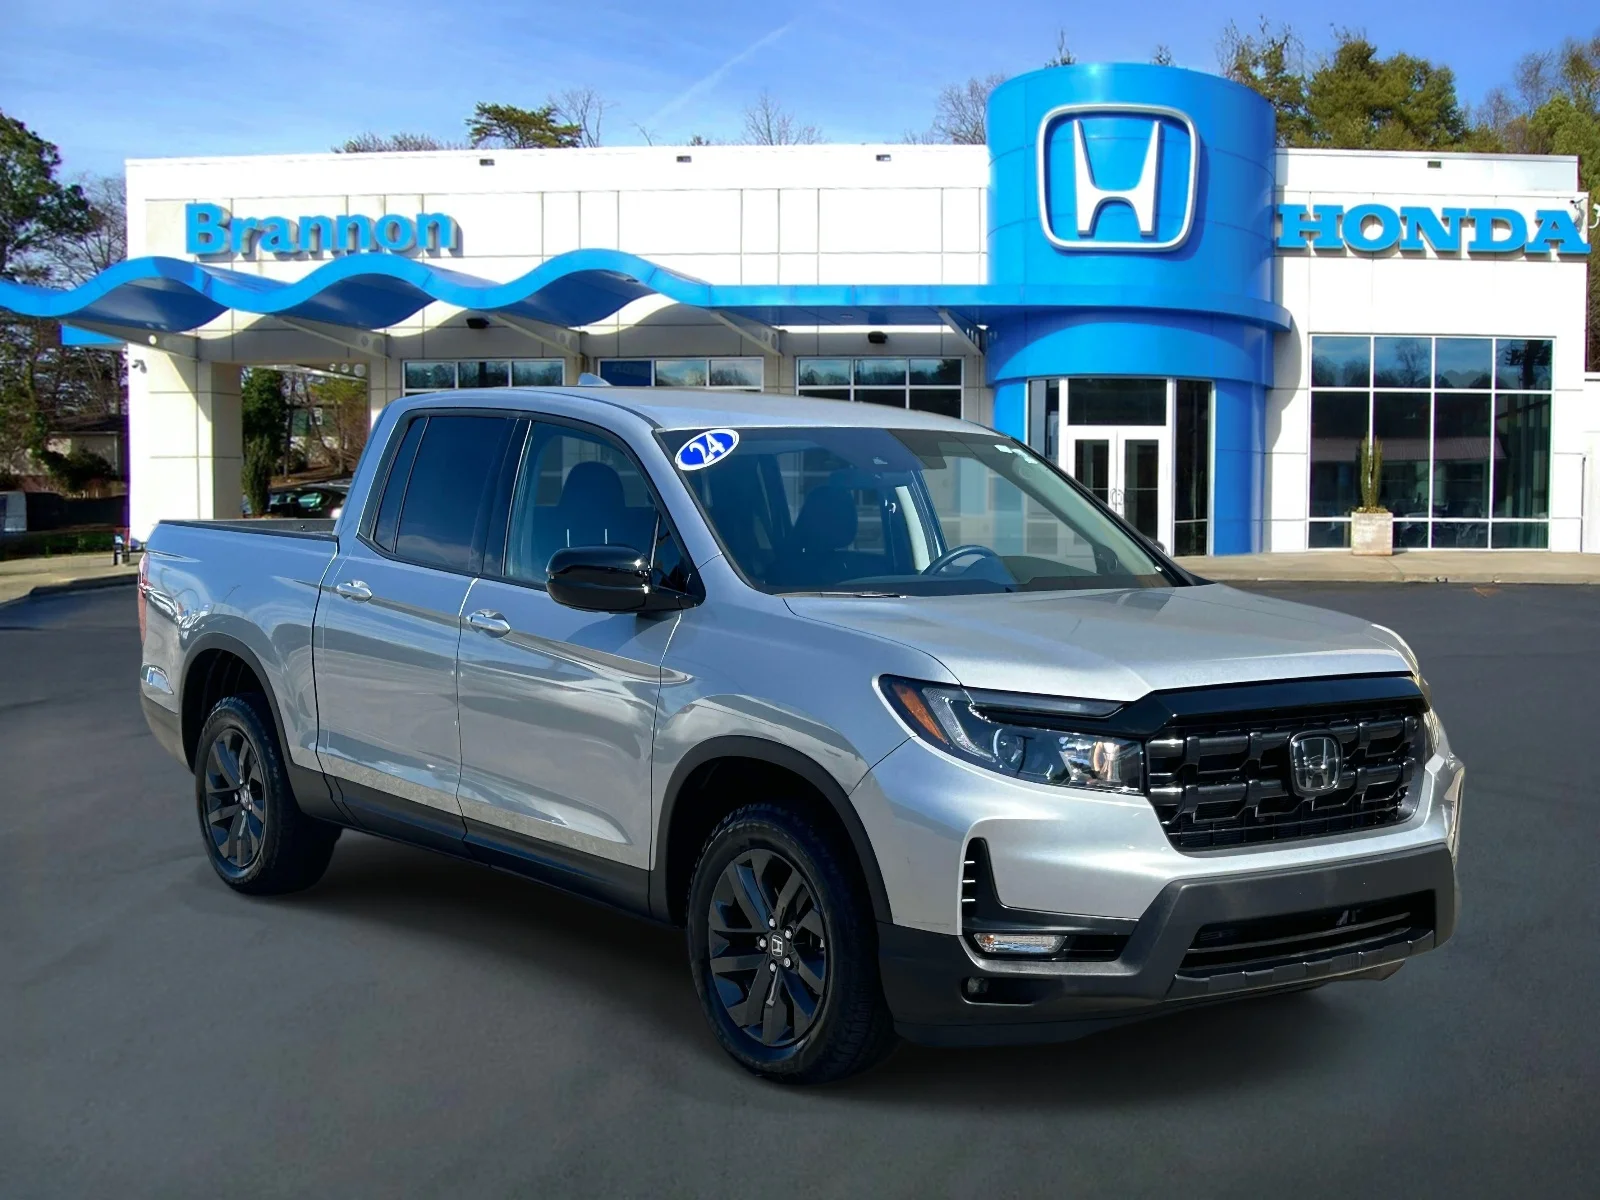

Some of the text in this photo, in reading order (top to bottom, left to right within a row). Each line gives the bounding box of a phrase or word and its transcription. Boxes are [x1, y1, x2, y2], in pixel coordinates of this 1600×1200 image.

[185, 202, 458, 255] Brannon
[1276, 203, 1592, 254] HONDA
[688, 432, 726, 465] 24
